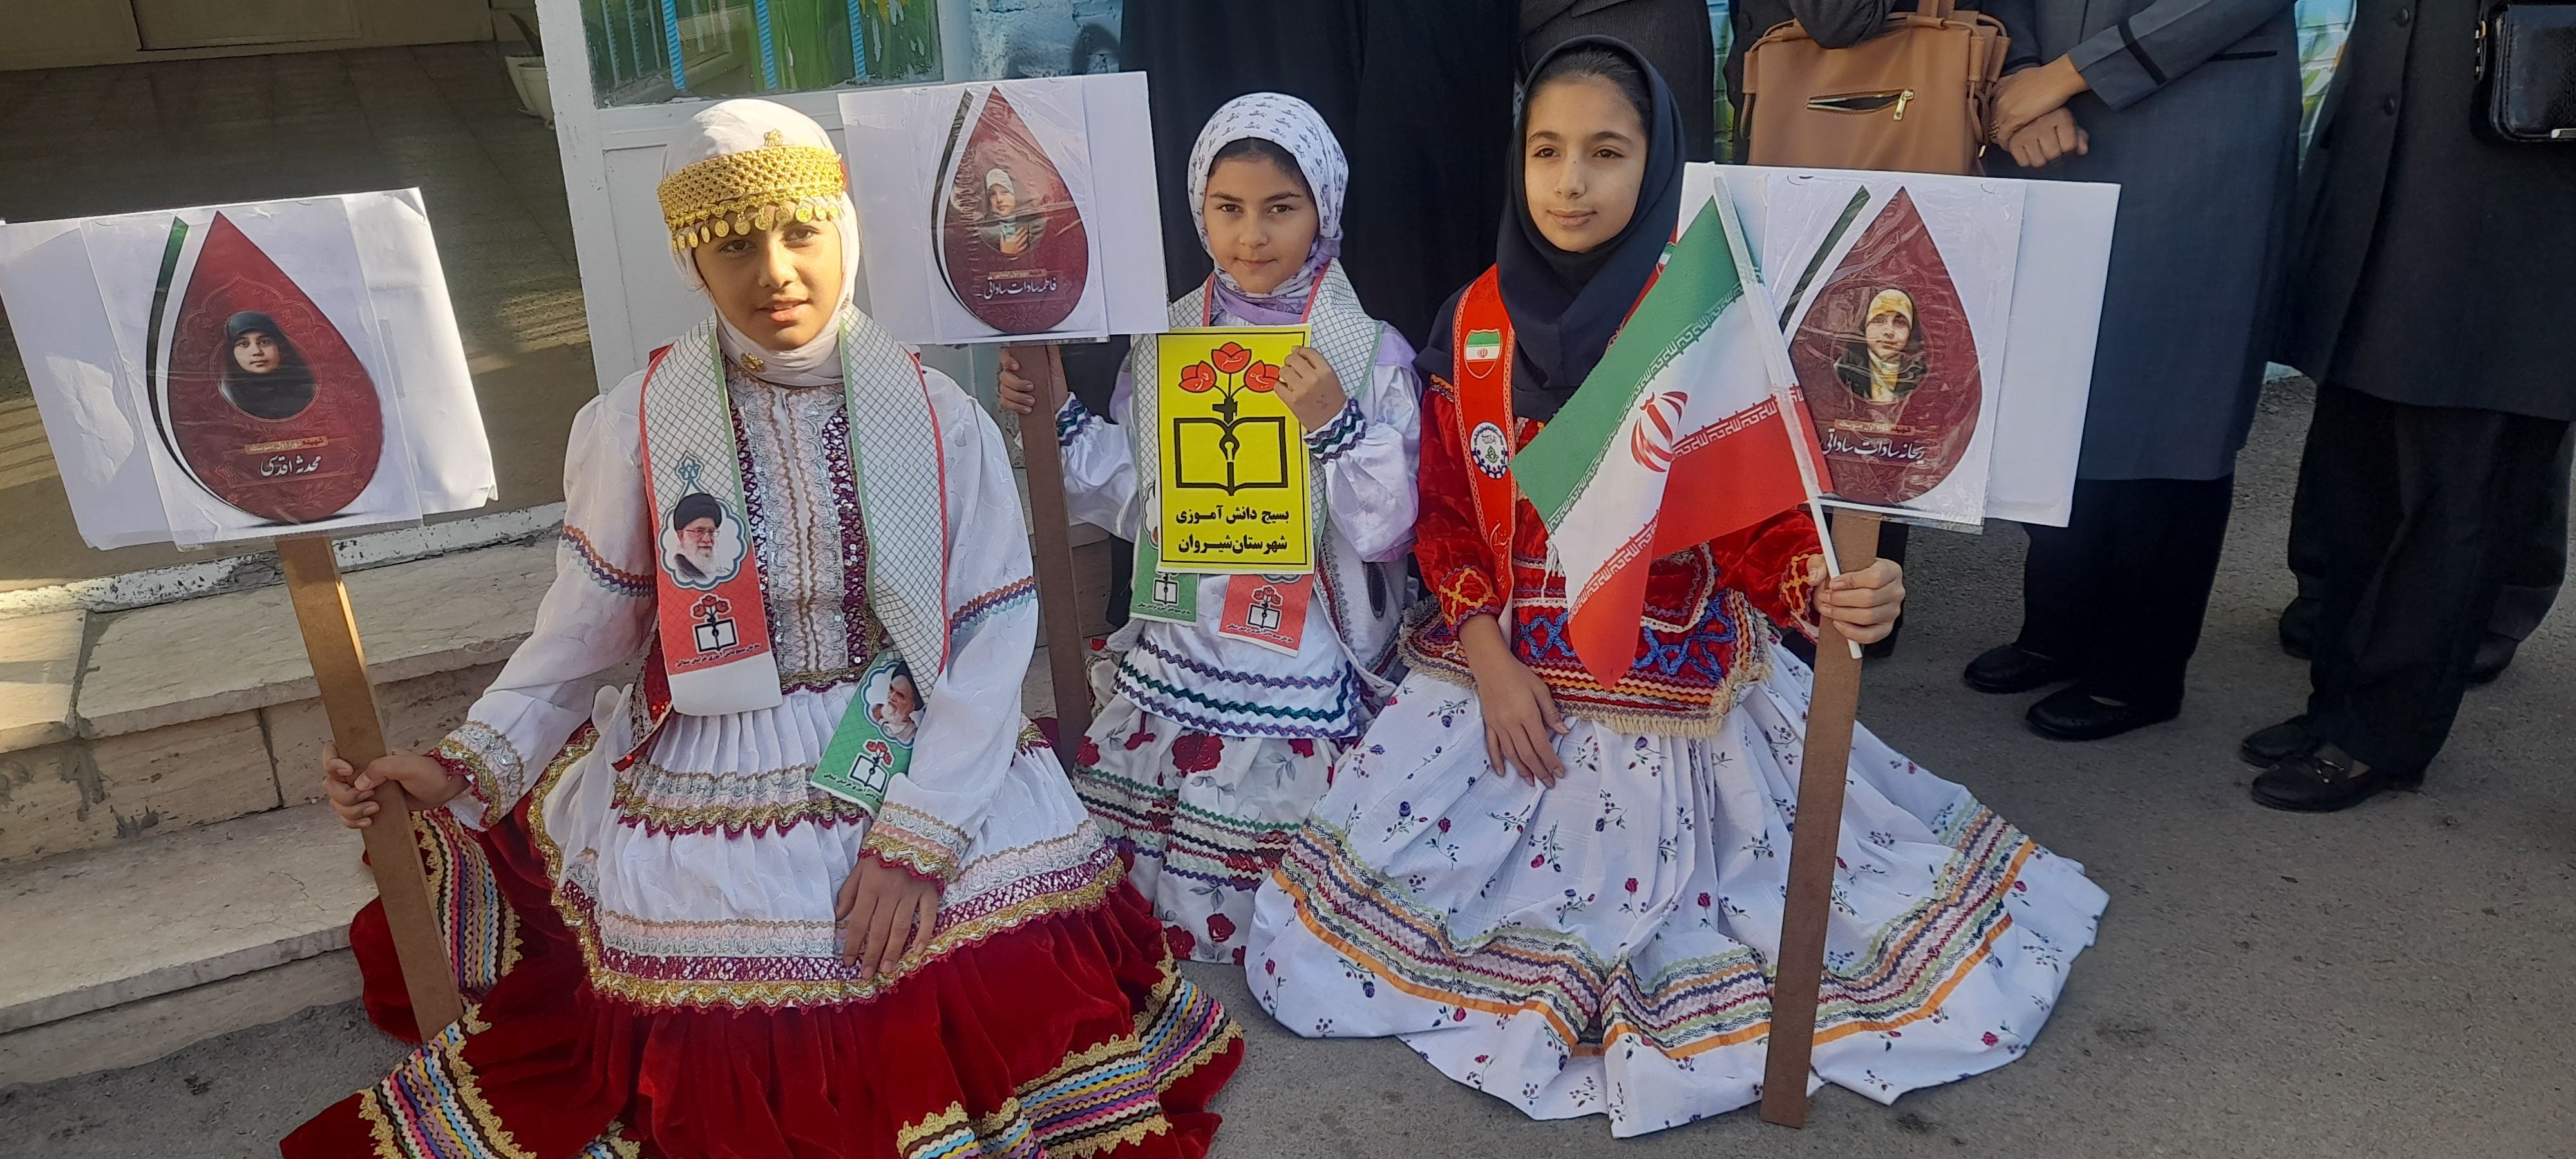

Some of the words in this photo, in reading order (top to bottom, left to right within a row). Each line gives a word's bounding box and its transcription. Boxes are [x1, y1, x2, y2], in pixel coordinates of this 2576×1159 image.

[984, 276, 1007, 300] ساداتی
[1007, 280, 1039, 294] سادات
[1037, 277, 1057, 292] فاطمه
[1823, 428, 1854, 455] ساداتی
[1854, 440, 1899, 457] سادات
[1897, 443, 1926, 464] ریحانه
[260, 455, 293, 476] اقدسی
[296, 455, 322, 475] محدثه
[1175, 505, 1224, 524] آموزی
[1226, 506, 1257, 524] دانش
[1261, 510, 1289, 524] بسیج
[1178, 533, 1233, 554] شیروان
[1232, 534, 1287, 555] شهرستان
